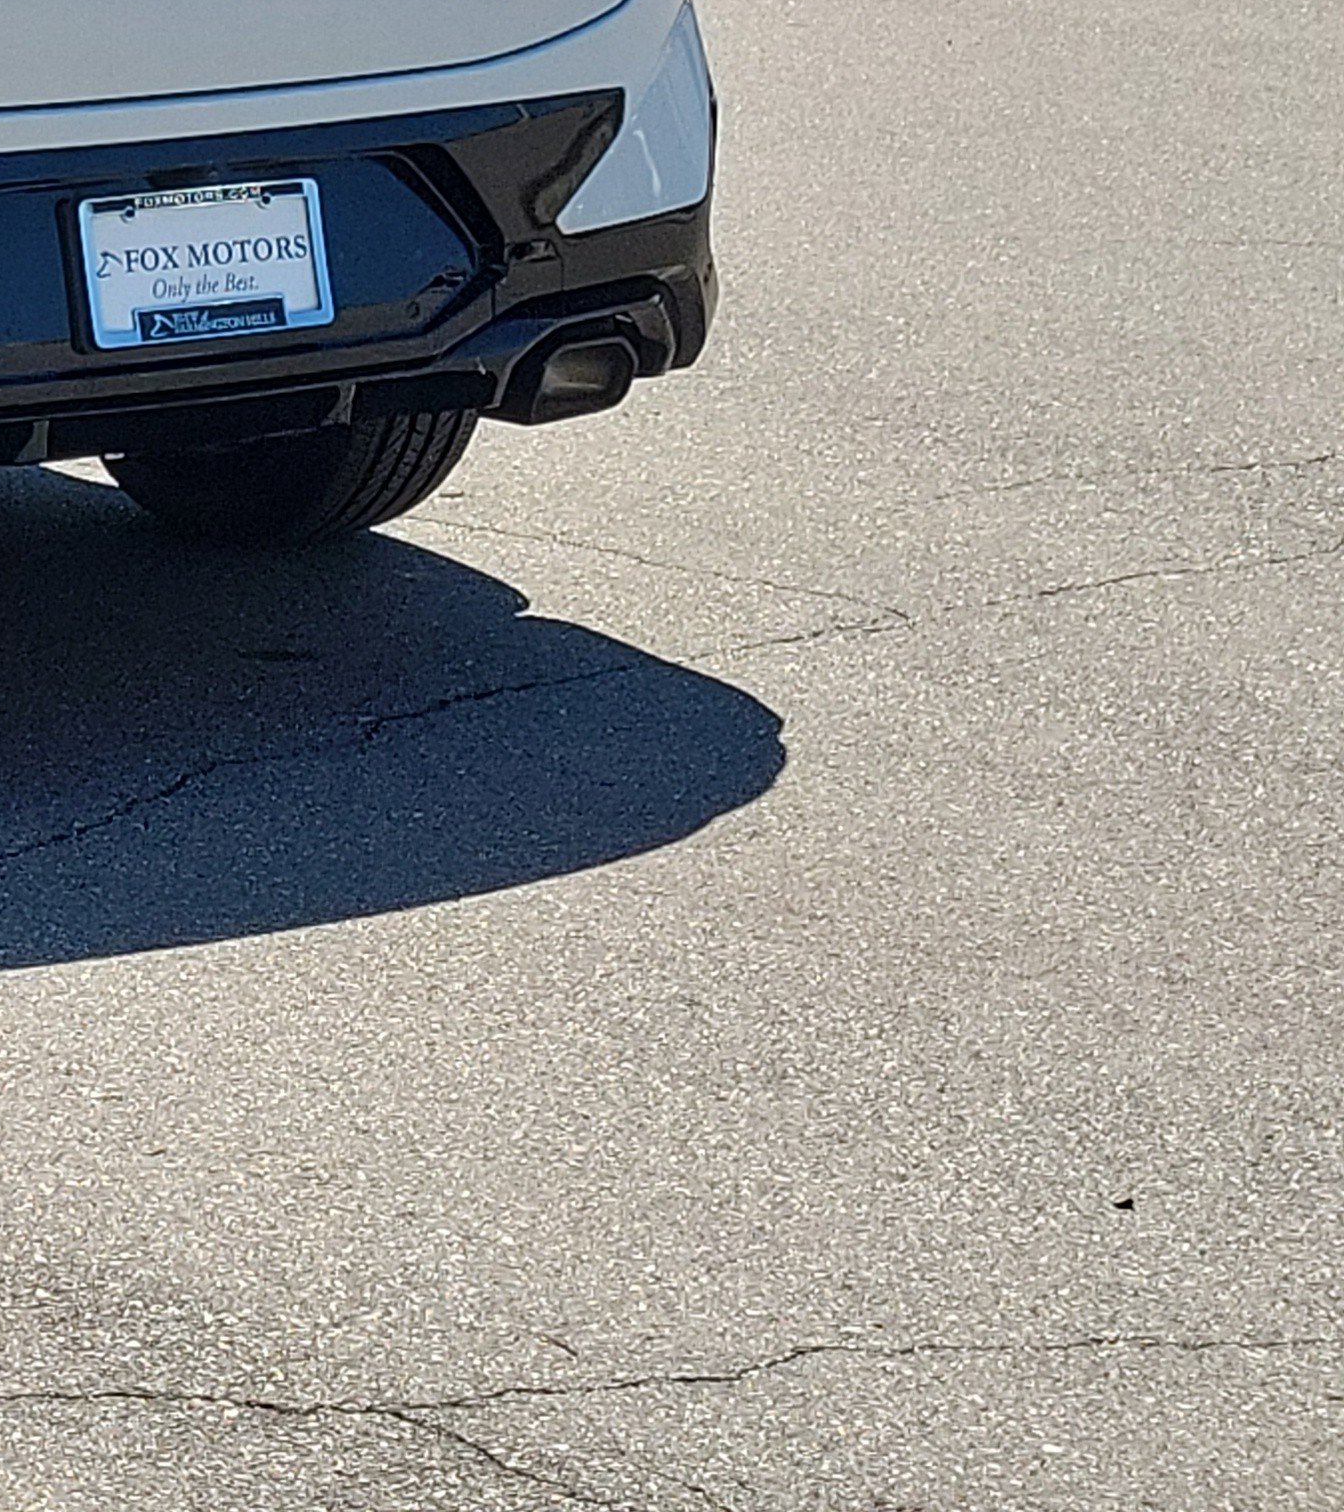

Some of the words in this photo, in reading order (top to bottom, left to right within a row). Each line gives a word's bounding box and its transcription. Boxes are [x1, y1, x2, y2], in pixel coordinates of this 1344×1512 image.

[125, 246, 179, 273] FOX
[188, 235, 308, 267] MOTORS
[153, 276, 191, 302] Only
[196, 274, 219, 295] the
[225, 272, 259, 293] Best.
